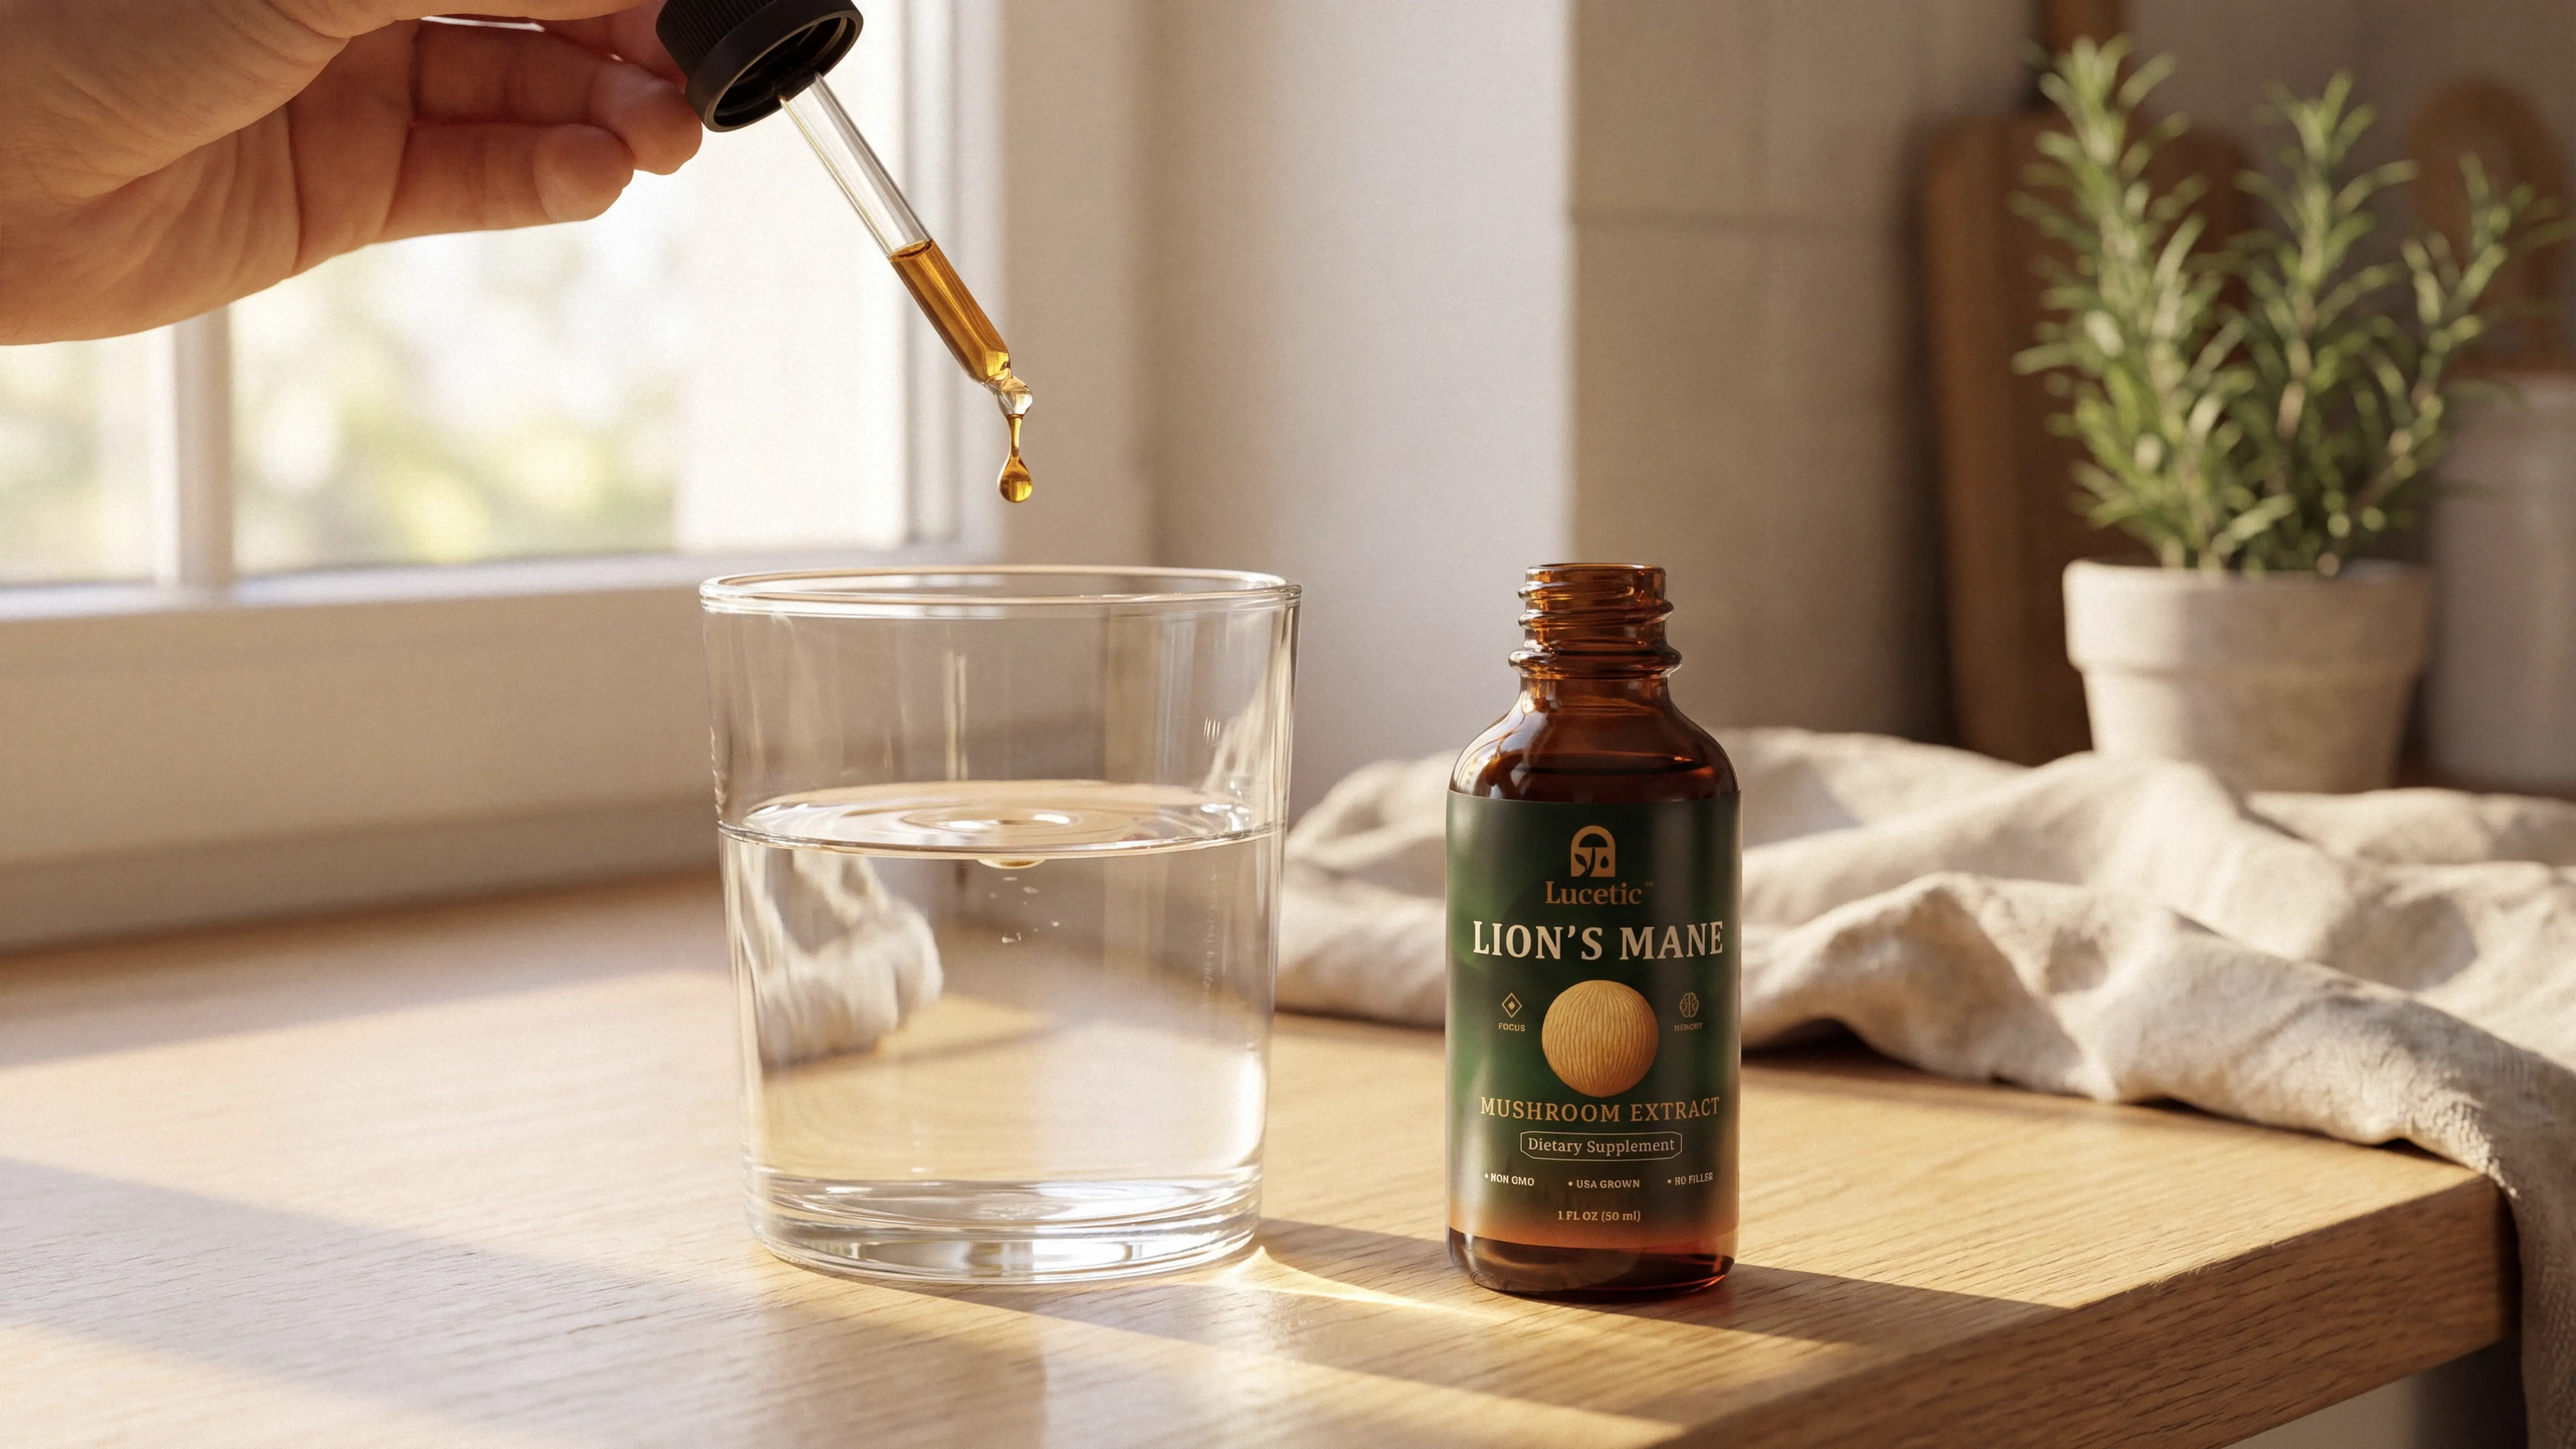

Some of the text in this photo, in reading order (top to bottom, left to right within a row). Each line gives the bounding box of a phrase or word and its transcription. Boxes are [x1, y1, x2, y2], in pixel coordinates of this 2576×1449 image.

[1545, 881, 1642, 905] Lucetic
[1473, 920, 1723, 961] LION'S MANE
[1480, 1096, 1720, 1122] MUSHROOM EXTRACT
[1528, 1137, 1674, 1156] Dietary Supplement
[1490, 1173, 1534, 1186] NON GMO
[1576, 1179, 1640, 1188] USA GROWN
[1558, 1210, 1564, 1220] 1
[1582, 1211, 1598, 1221] OZ
[1601, 1210, 1619, 1223] (50
[1622, 1210, 1641, 1223] ml)
